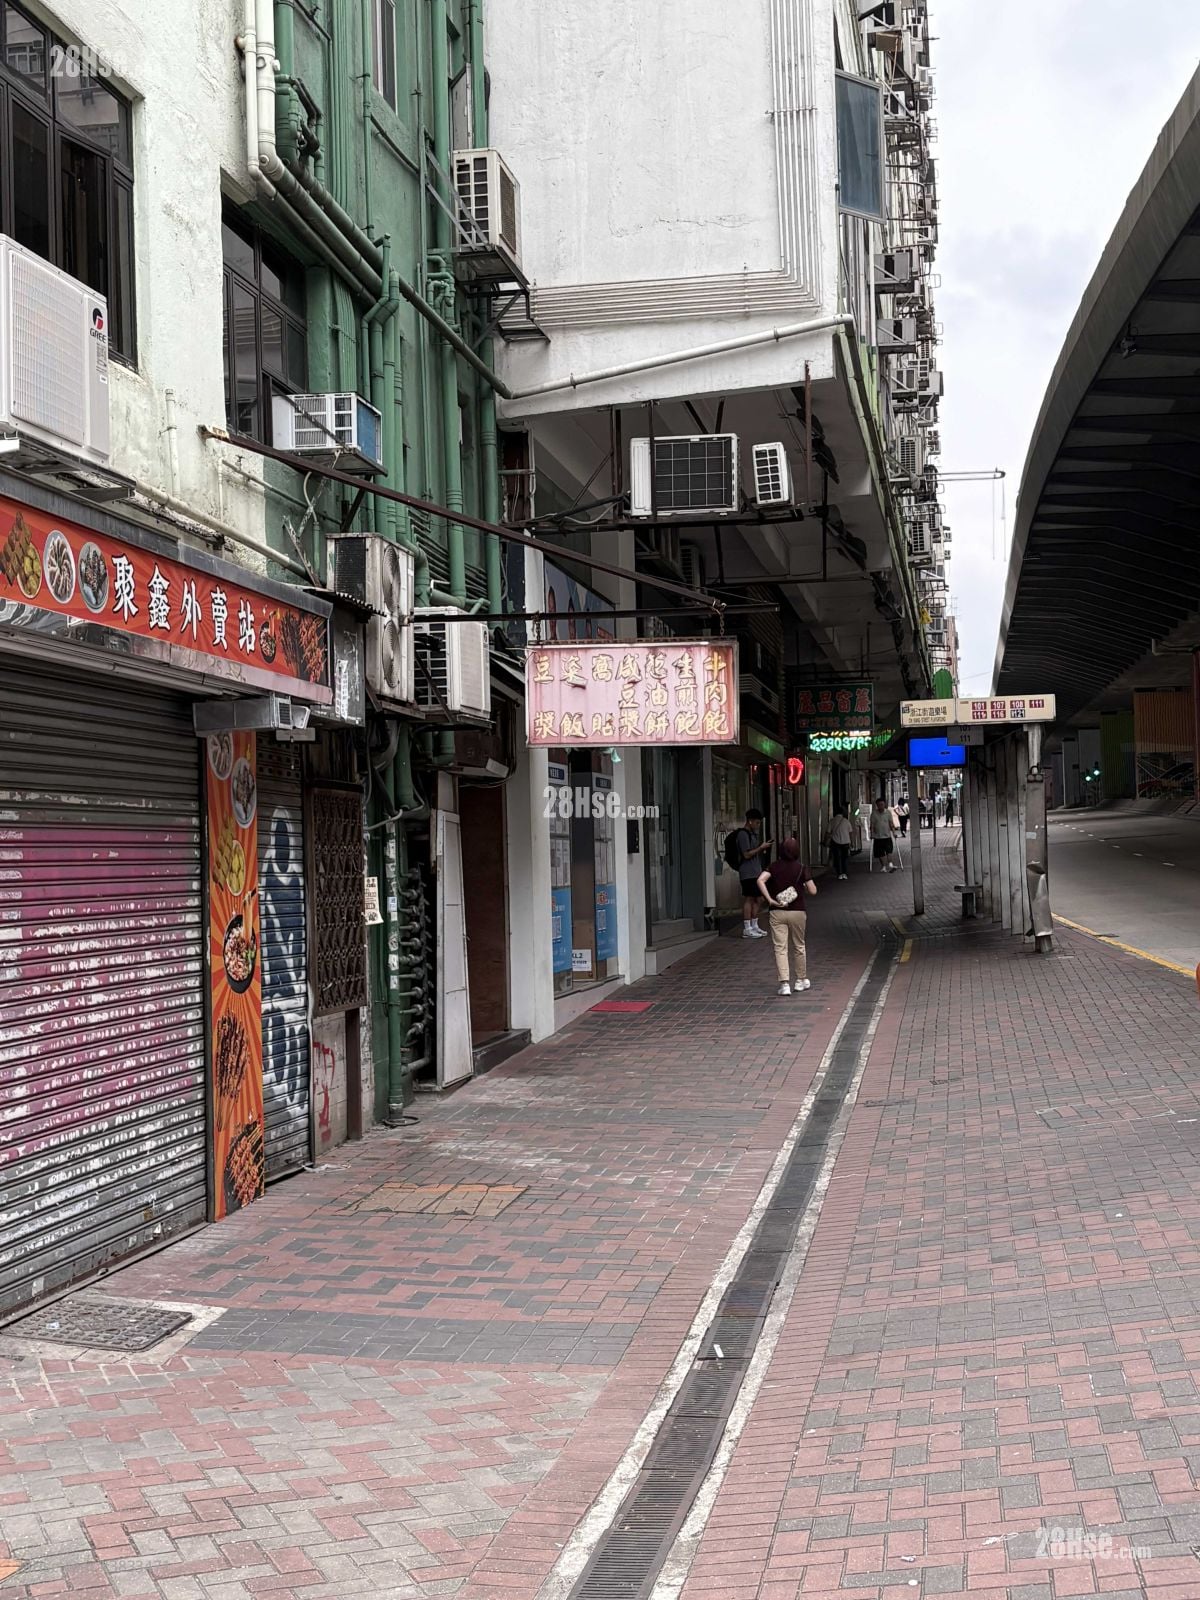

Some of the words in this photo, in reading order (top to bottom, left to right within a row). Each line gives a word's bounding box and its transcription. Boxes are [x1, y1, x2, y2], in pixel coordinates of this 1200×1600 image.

[89, 327, 108, 344] GREE
[111, 553, 256, 655] 聚鑫外賣站
[1030, 699, 1044, 708] 111
